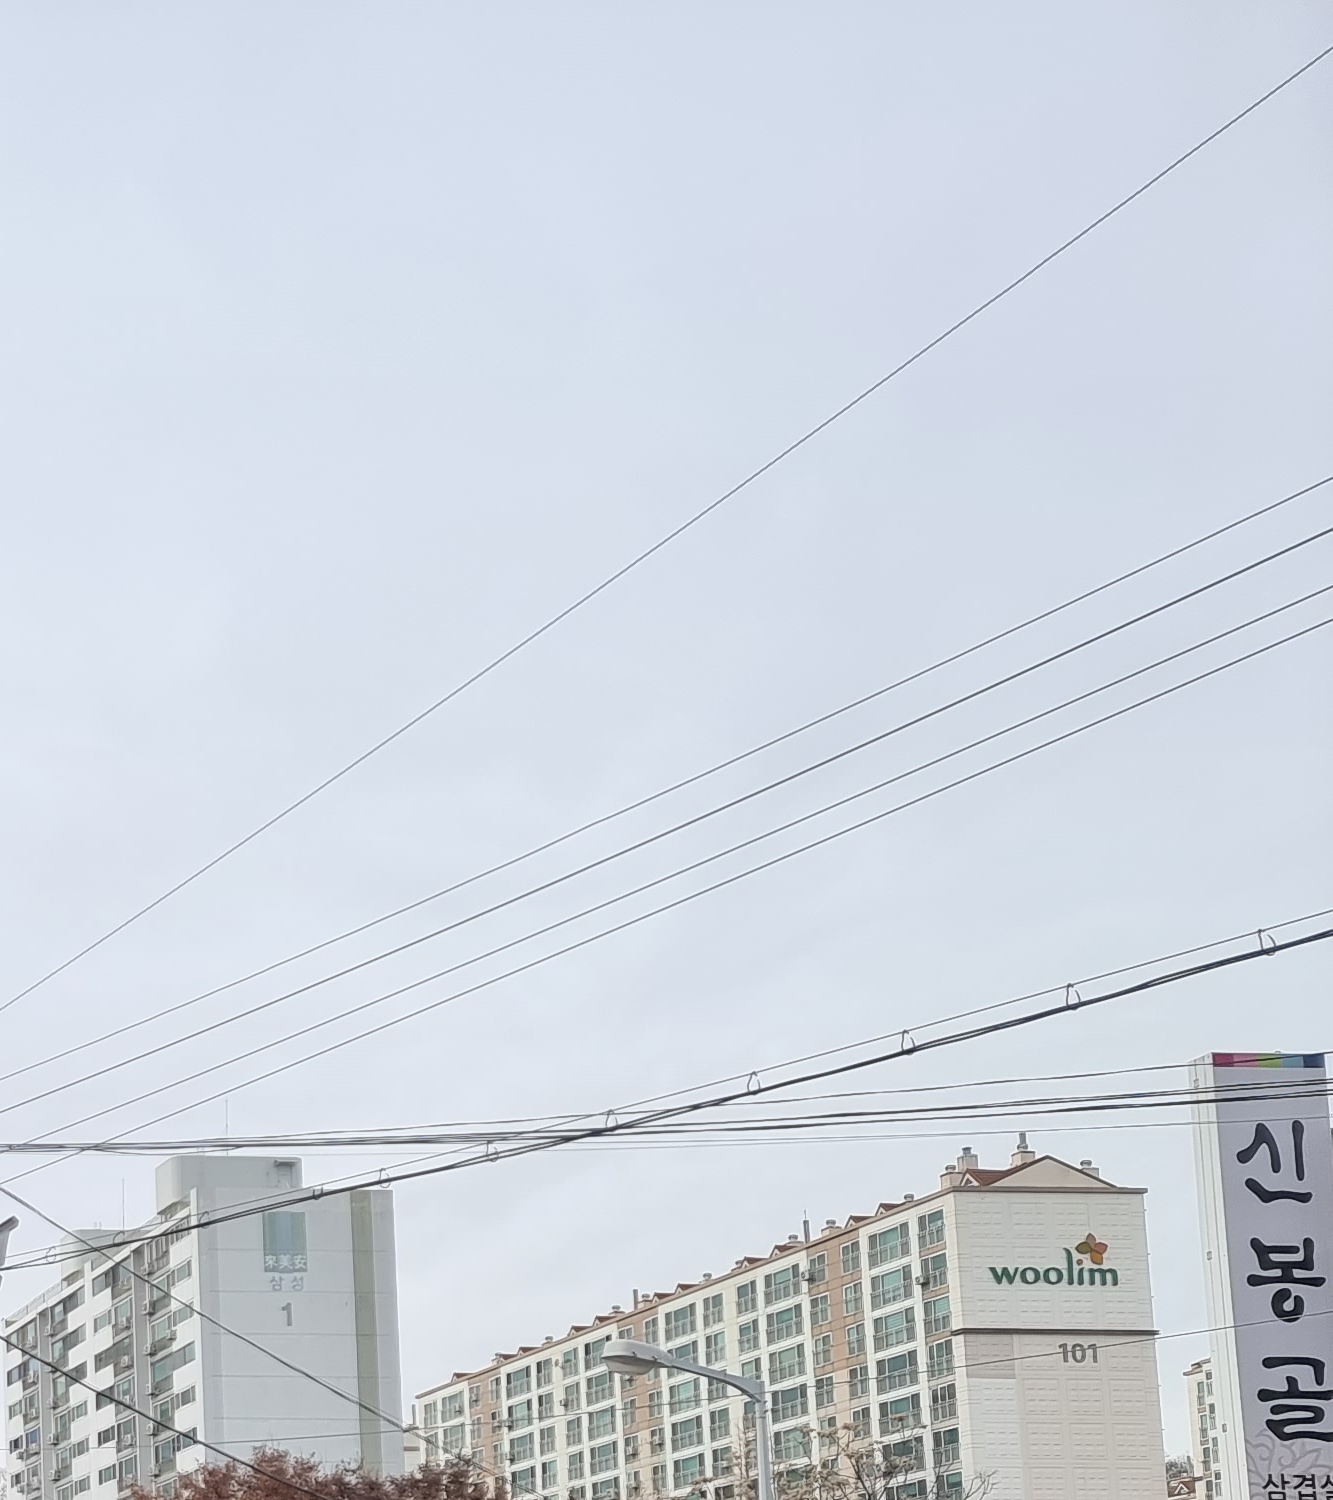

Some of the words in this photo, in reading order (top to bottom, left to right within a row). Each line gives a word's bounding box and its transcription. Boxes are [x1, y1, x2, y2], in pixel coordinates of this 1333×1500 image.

[987, 1247, 1119, 1287] woolim
[269, 1275, 304, 1292] 삼성
[1237, 1119, 1333, 1442] 신봉골
[281, 1302, 293, 1327] 1
[1057, 1342, 1099, 1364] 101
